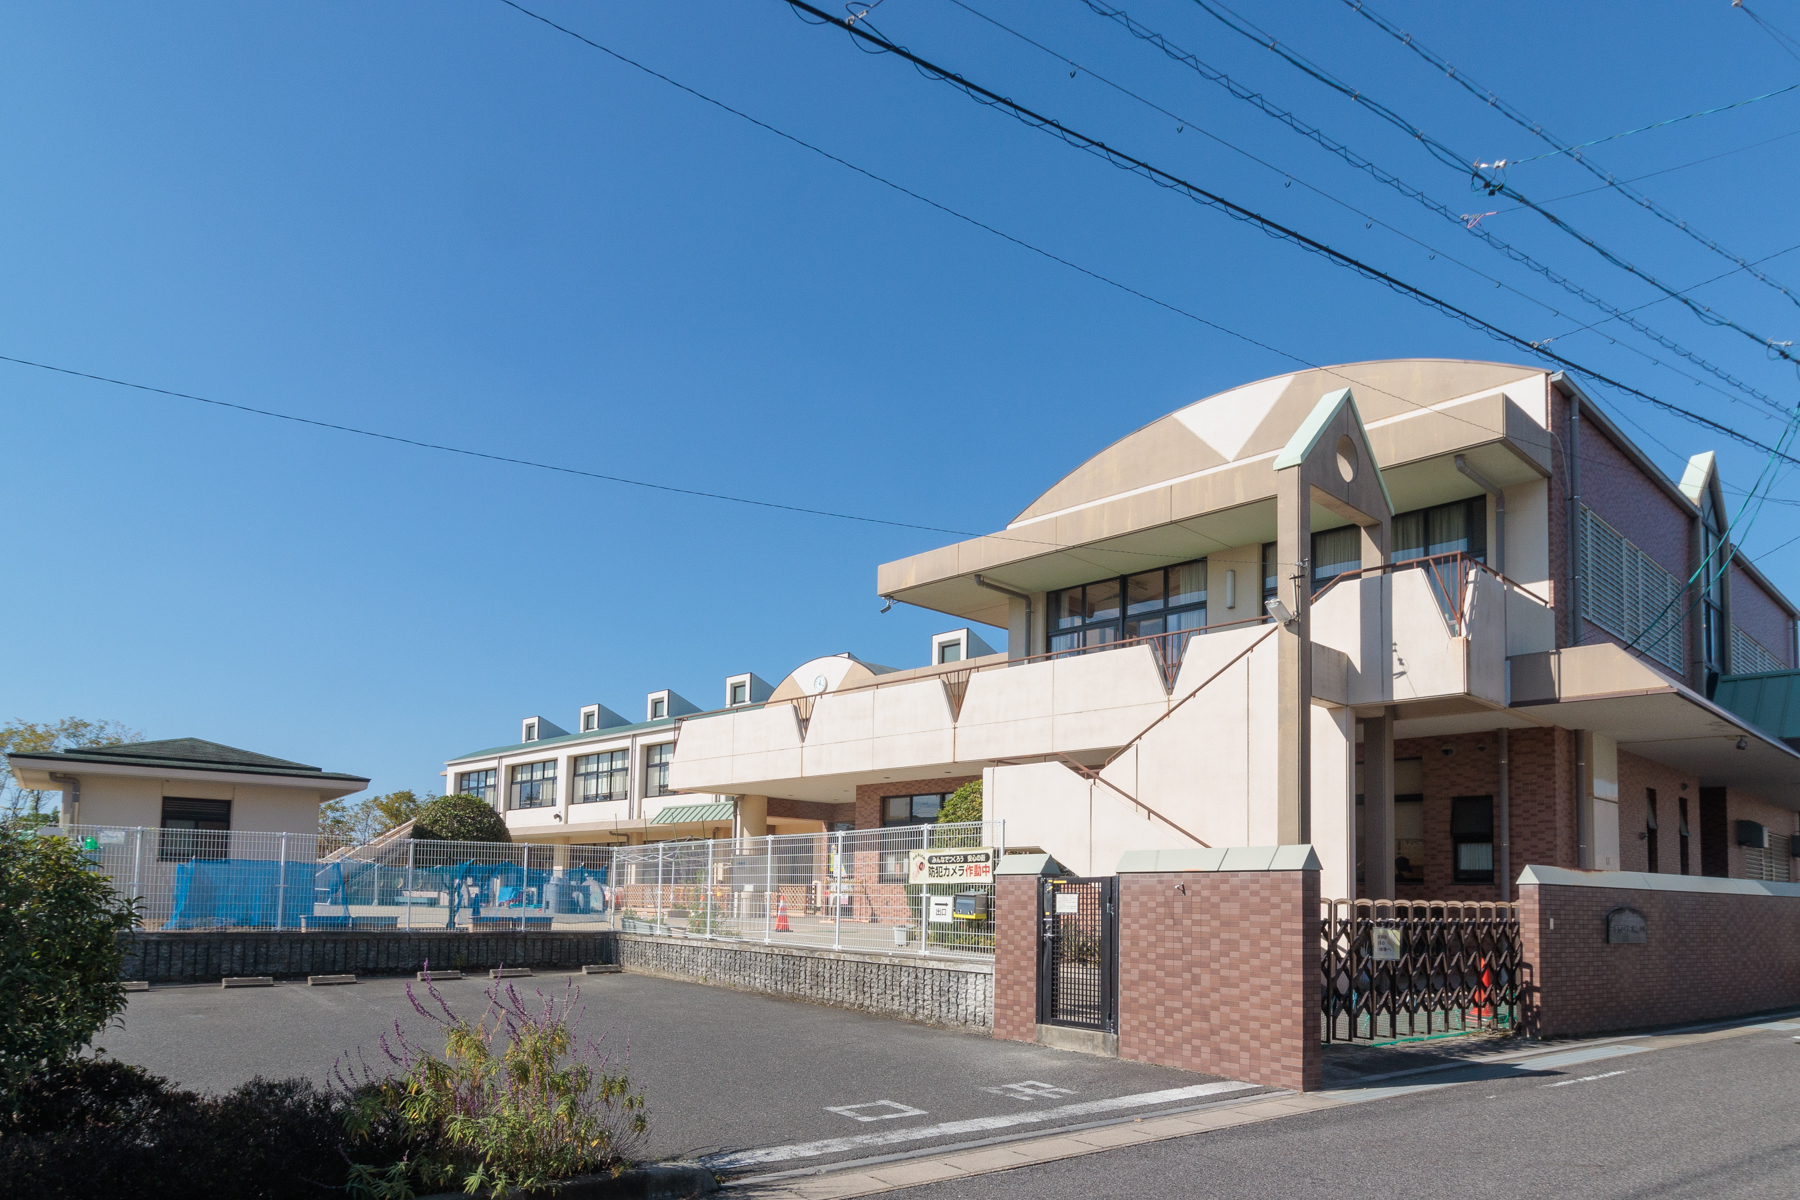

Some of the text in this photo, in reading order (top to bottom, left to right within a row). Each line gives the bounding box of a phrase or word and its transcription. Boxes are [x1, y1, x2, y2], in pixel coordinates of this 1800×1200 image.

[928, 865, 990, 878] 防犯カメラ作動中
[936, 908, 947, 916] 出口
